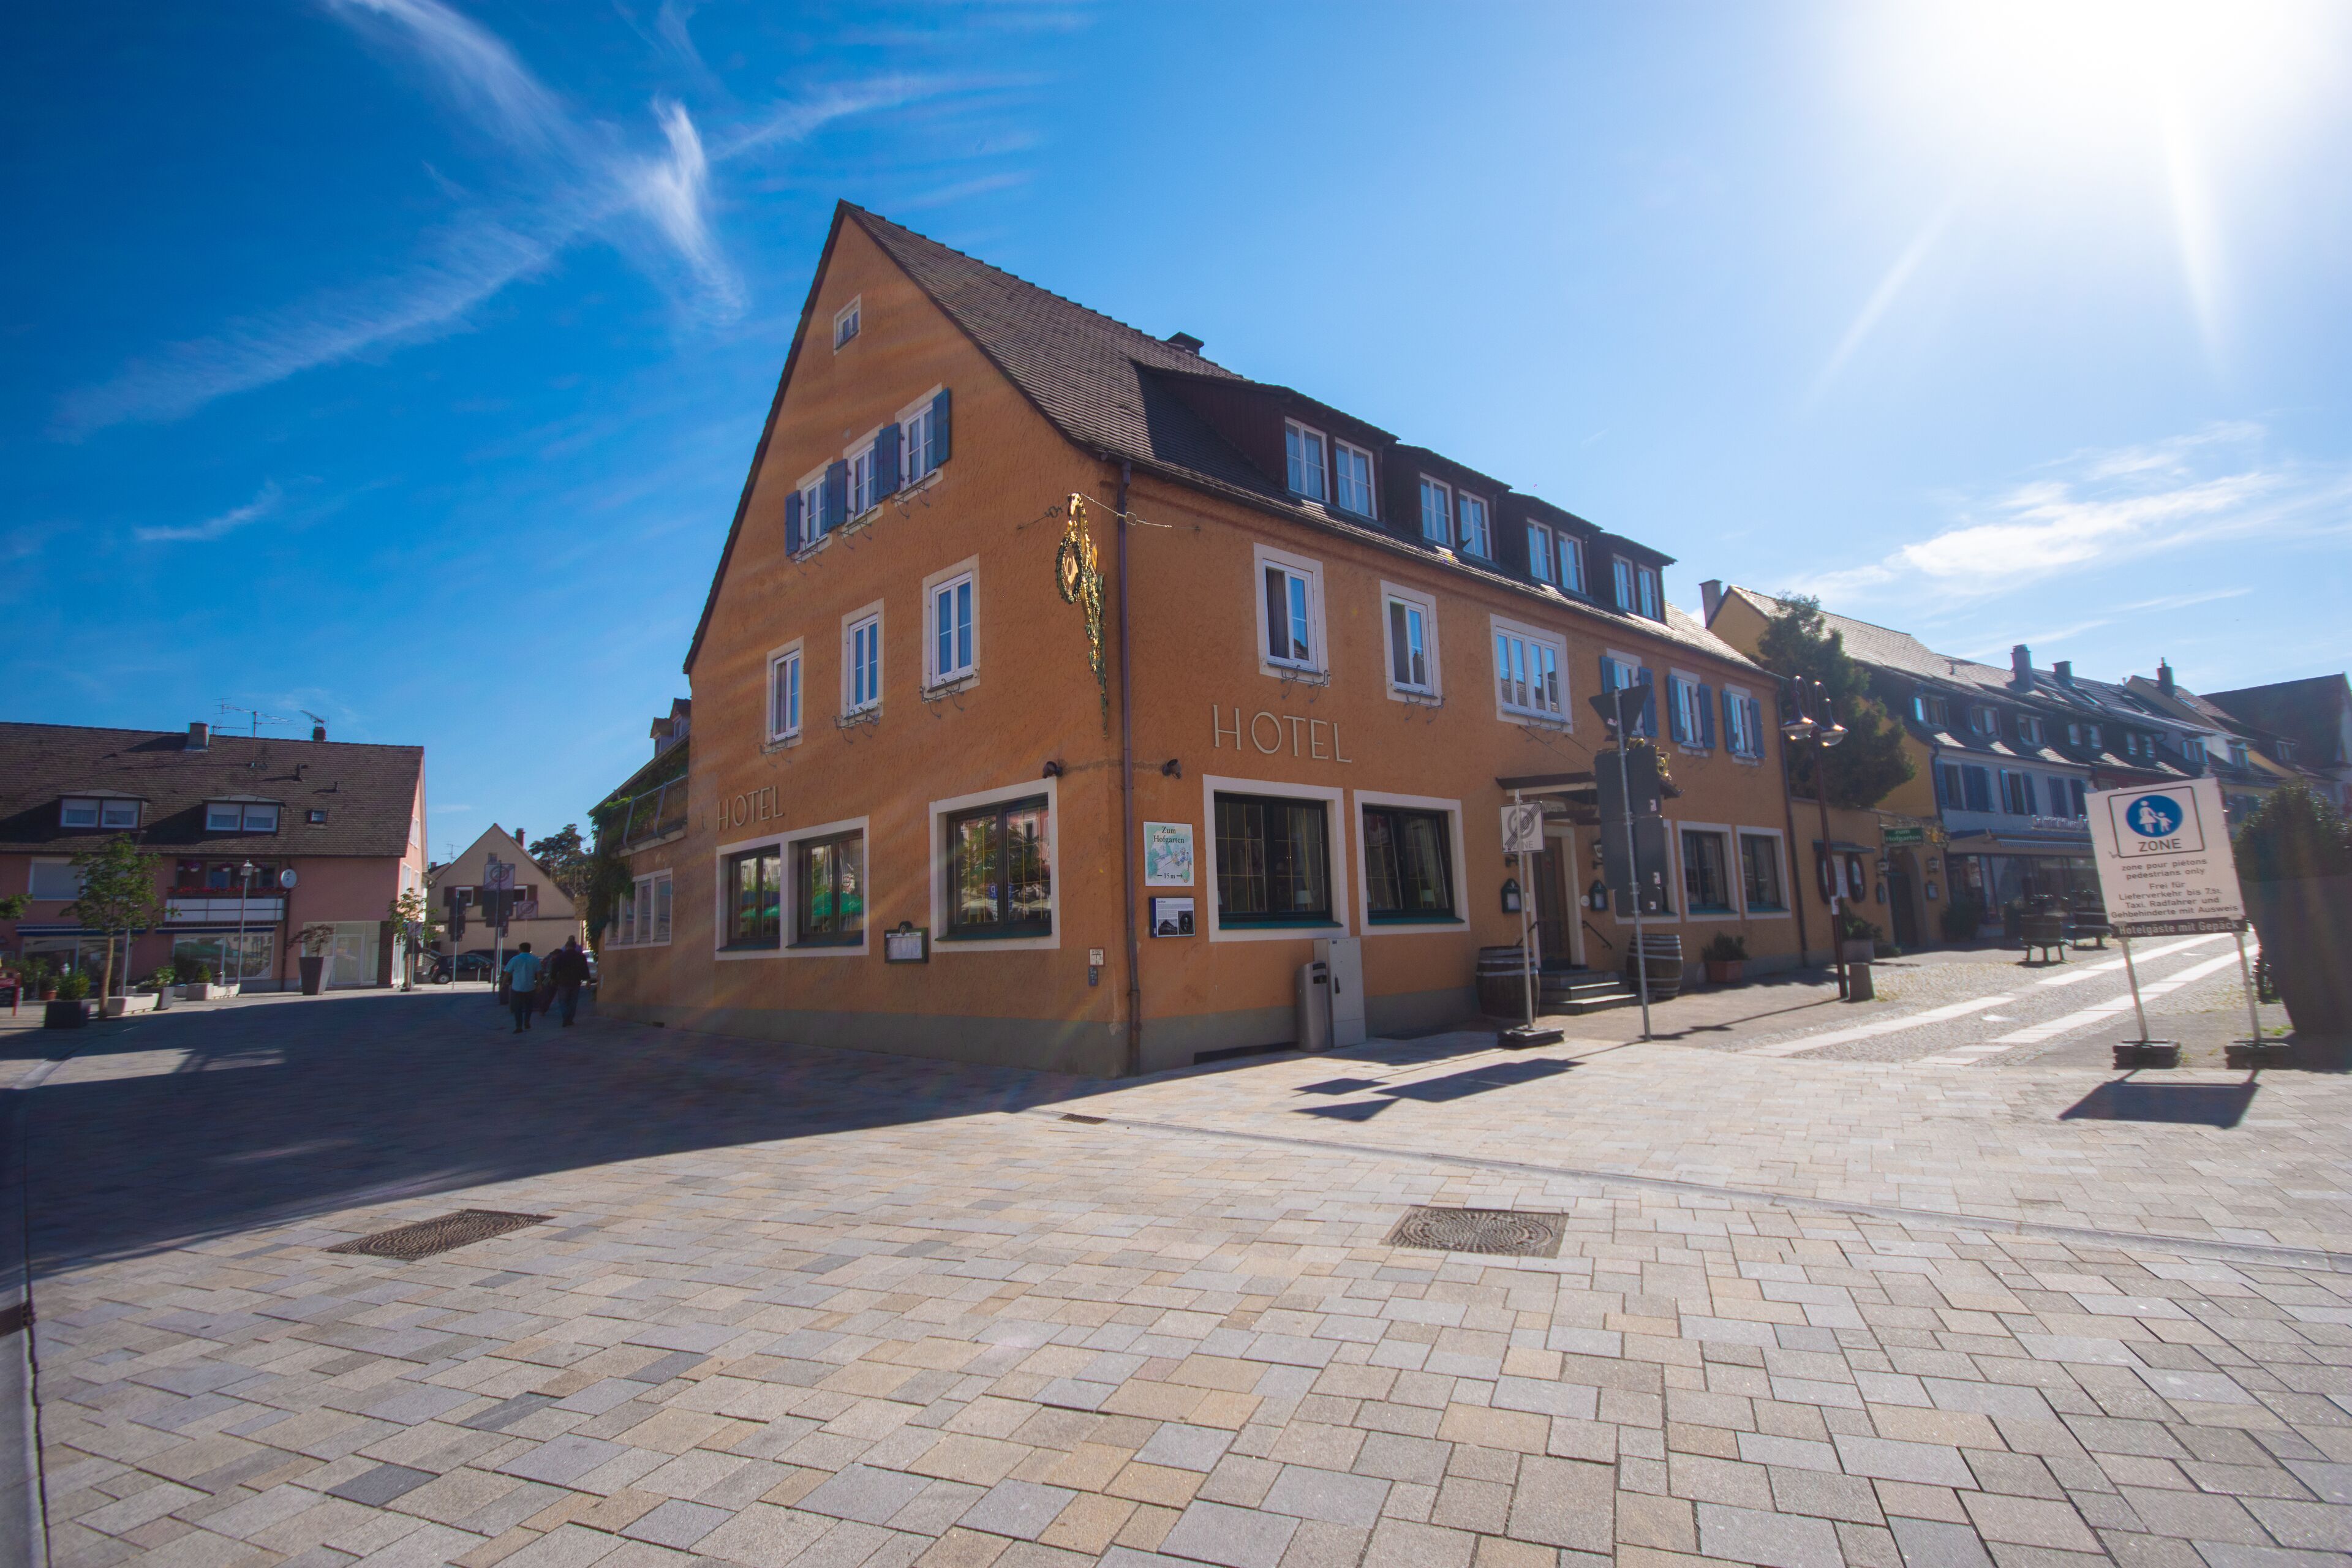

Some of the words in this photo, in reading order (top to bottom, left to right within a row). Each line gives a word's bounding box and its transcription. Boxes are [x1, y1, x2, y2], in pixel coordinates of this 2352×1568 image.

[1213, 704, 1352, 763] HOTEL
[717, 786, 784, 831] HOTEL
[1153, 835, 1185, 844] Hofgarten
[2138, 839, 2182, 852] ZONE
[2127, 870, 2181, 880] pedestrians
[2119, 891, 2182, 900] Lieferverkehr
[2150, 898, 2197, 907] Radfahrer
[2111, 908, 2176, 918] Gehbehinderte
[2179, 905, 2195, 914] mit
[2198, 905, 2239, 914] Ausweis
[2119, 924, 2175, 935] Hotelgäste
[2178, 922, 2196, 932] mit
[2198, 921, 2239, 932] Gepäck
